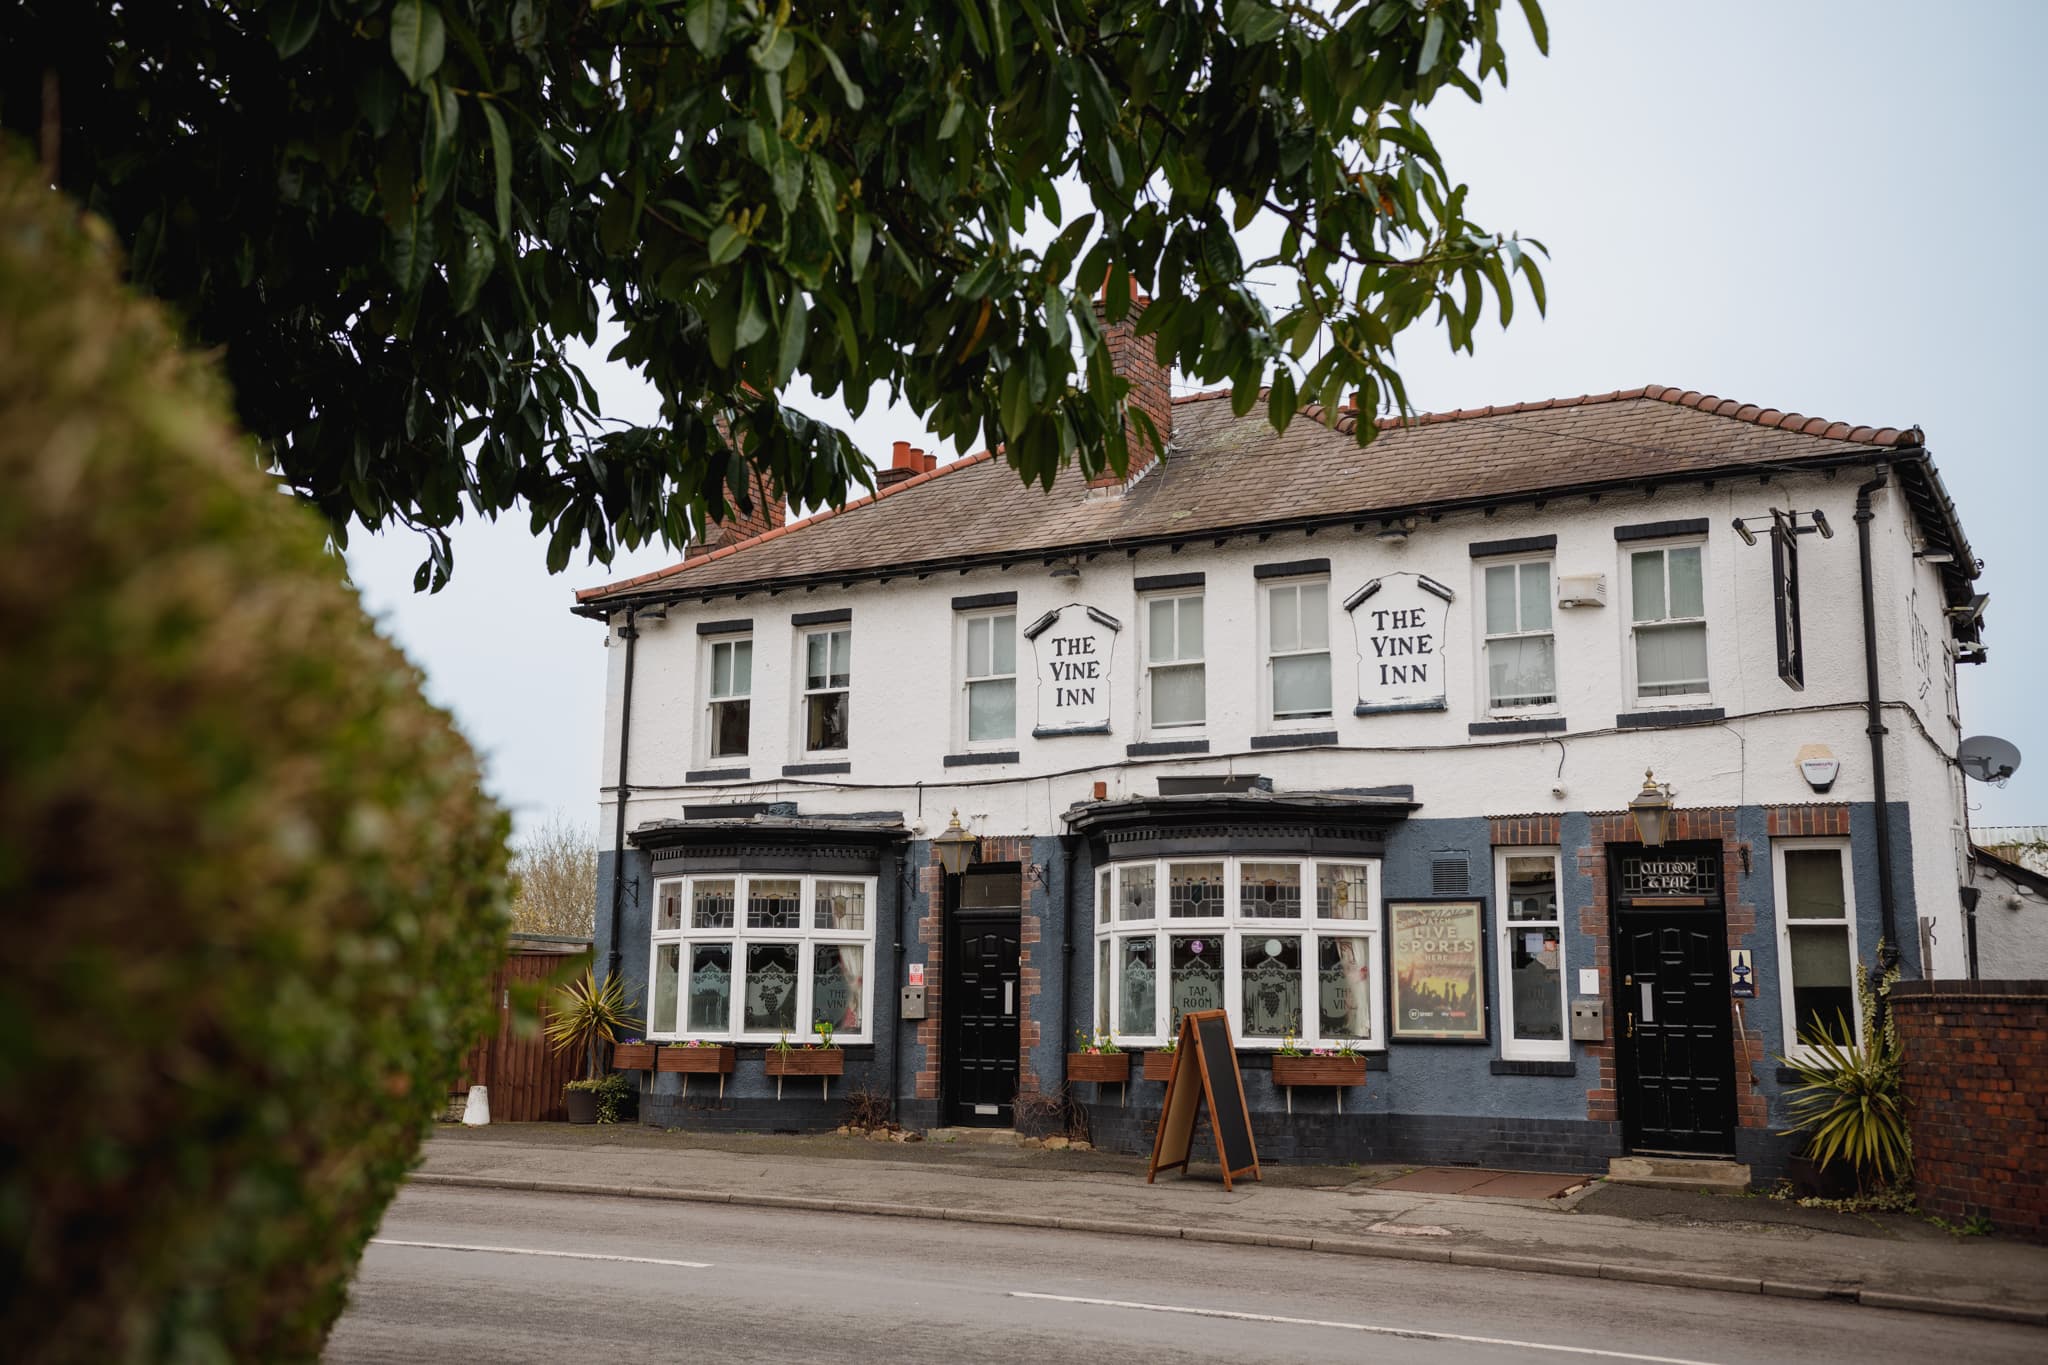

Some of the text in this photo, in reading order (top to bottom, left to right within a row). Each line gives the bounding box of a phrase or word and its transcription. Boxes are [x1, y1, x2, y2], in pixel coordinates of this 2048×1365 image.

[1371, 608, 1426, 632] THE
[1051, 635, 1096, 657] THE
[1370, 634, 1433, 658] VINE
[1049, 660, 1100, 682] VINE
[1379, 664, 1427, 686] INN
[1056, 687, 1096, 708] INN
[1647, 876, 1660, 888] &
[1419, 917, 1453, 926] WATCH
[1414, 926, 1457, 939] LIVE
[1399, 940, 1473, 953] SPORTS
[1188, 986, 1207, 996] TAP
[1183, 997, 1212, 1008] ROOM
